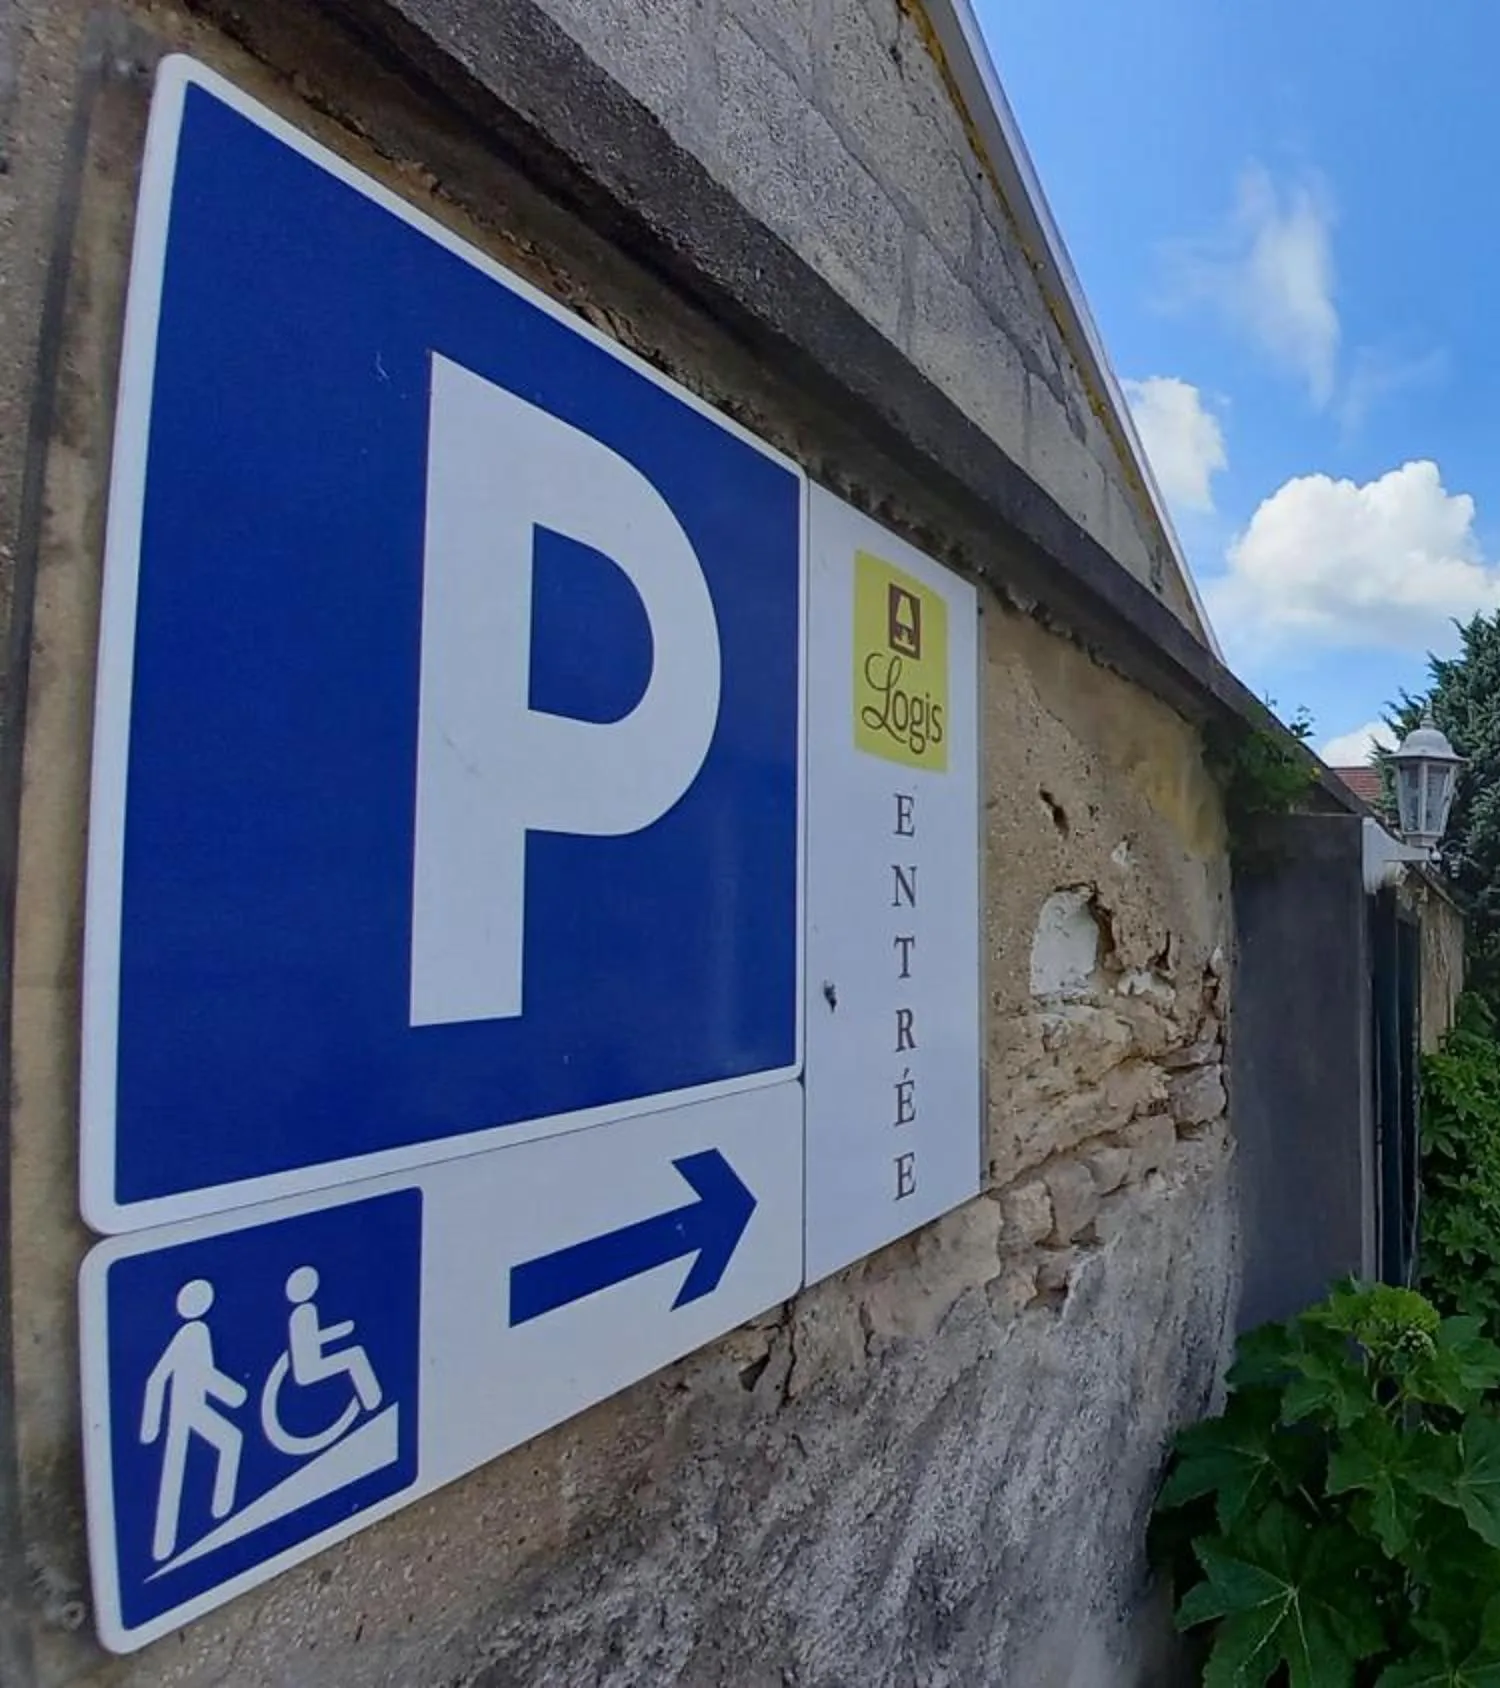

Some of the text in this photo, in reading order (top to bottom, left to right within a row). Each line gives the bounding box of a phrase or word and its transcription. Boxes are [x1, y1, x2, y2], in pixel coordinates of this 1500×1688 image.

[410, 351, 721, 1026] P
[862, 652, 943, 755] Logis
[891, 793, 917, 1200] ENTRÉE
